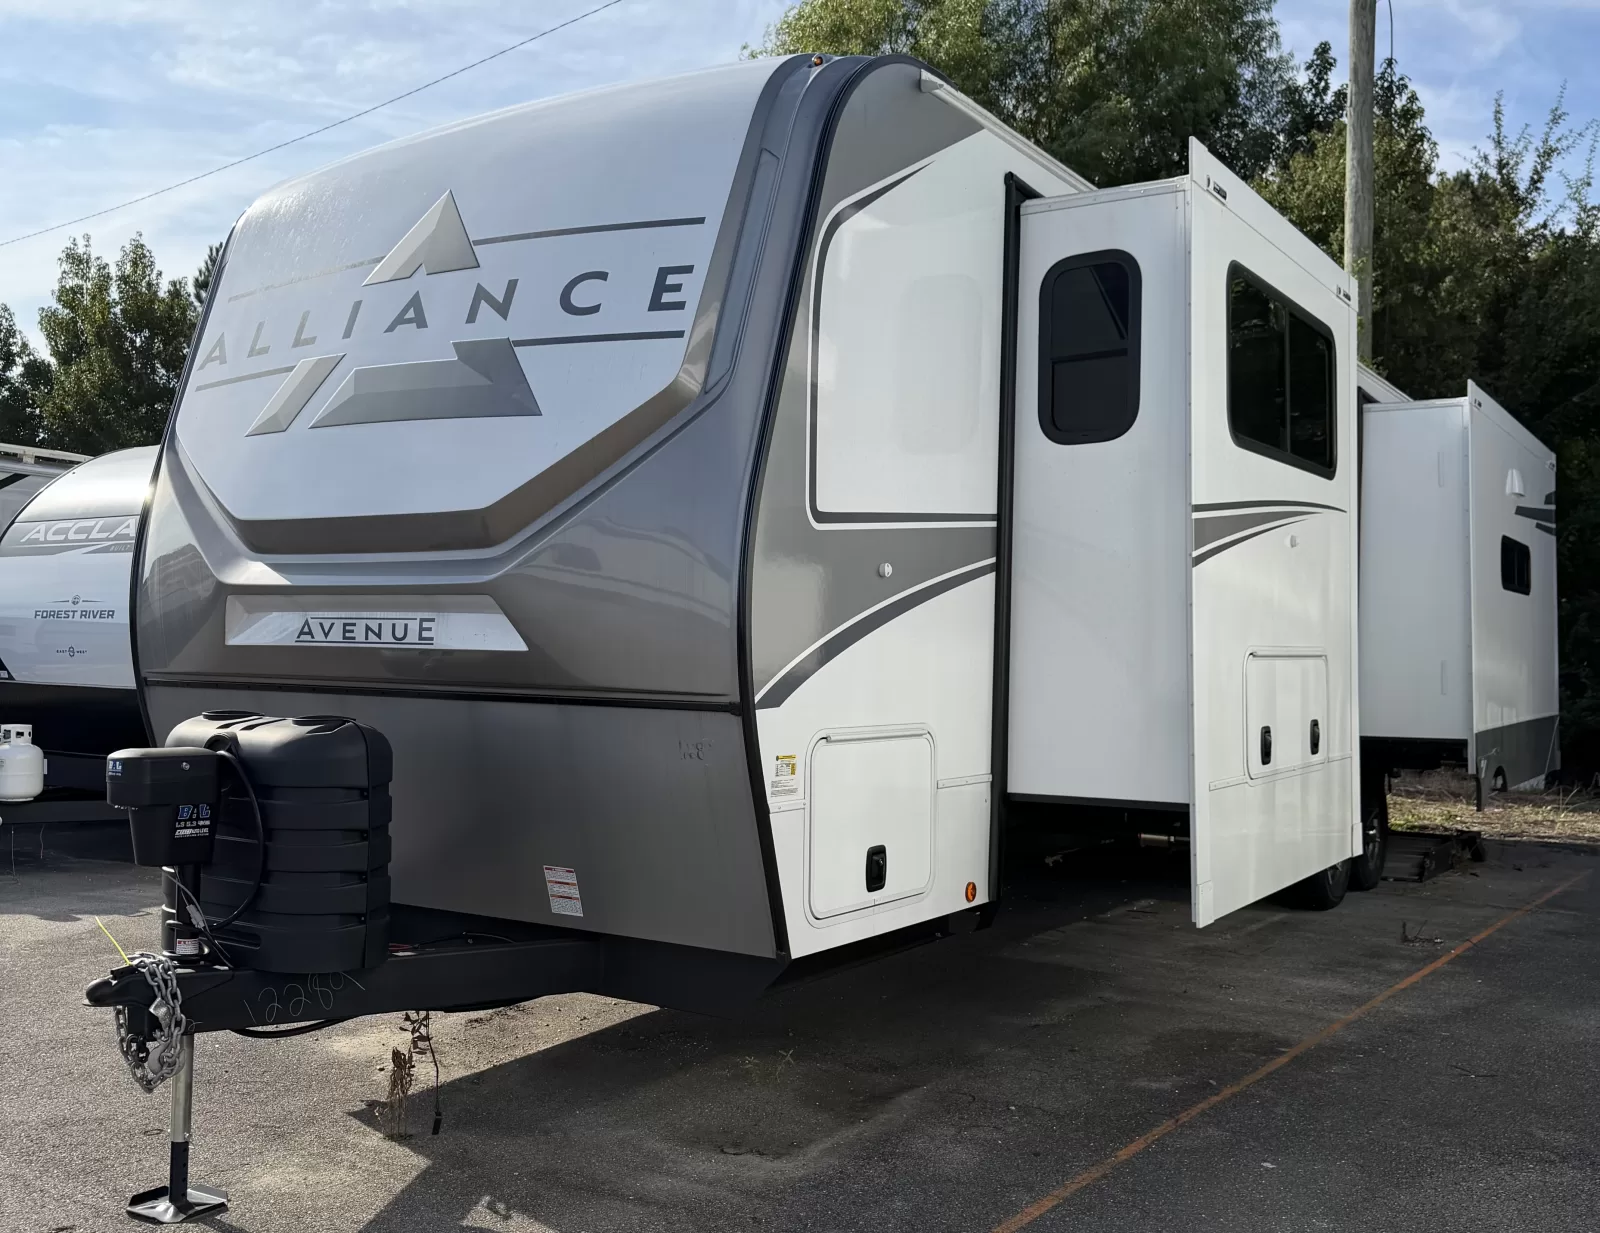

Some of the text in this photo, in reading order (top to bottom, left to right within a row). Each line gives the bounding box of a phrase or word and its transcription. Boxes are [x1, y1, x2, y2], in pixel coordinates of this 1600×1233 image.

[196, 264, 695, 372] ALLIANCE
[34, 609, 115, 619] FOREST RIVER
[296, 617, 436, 642] AVENUE
